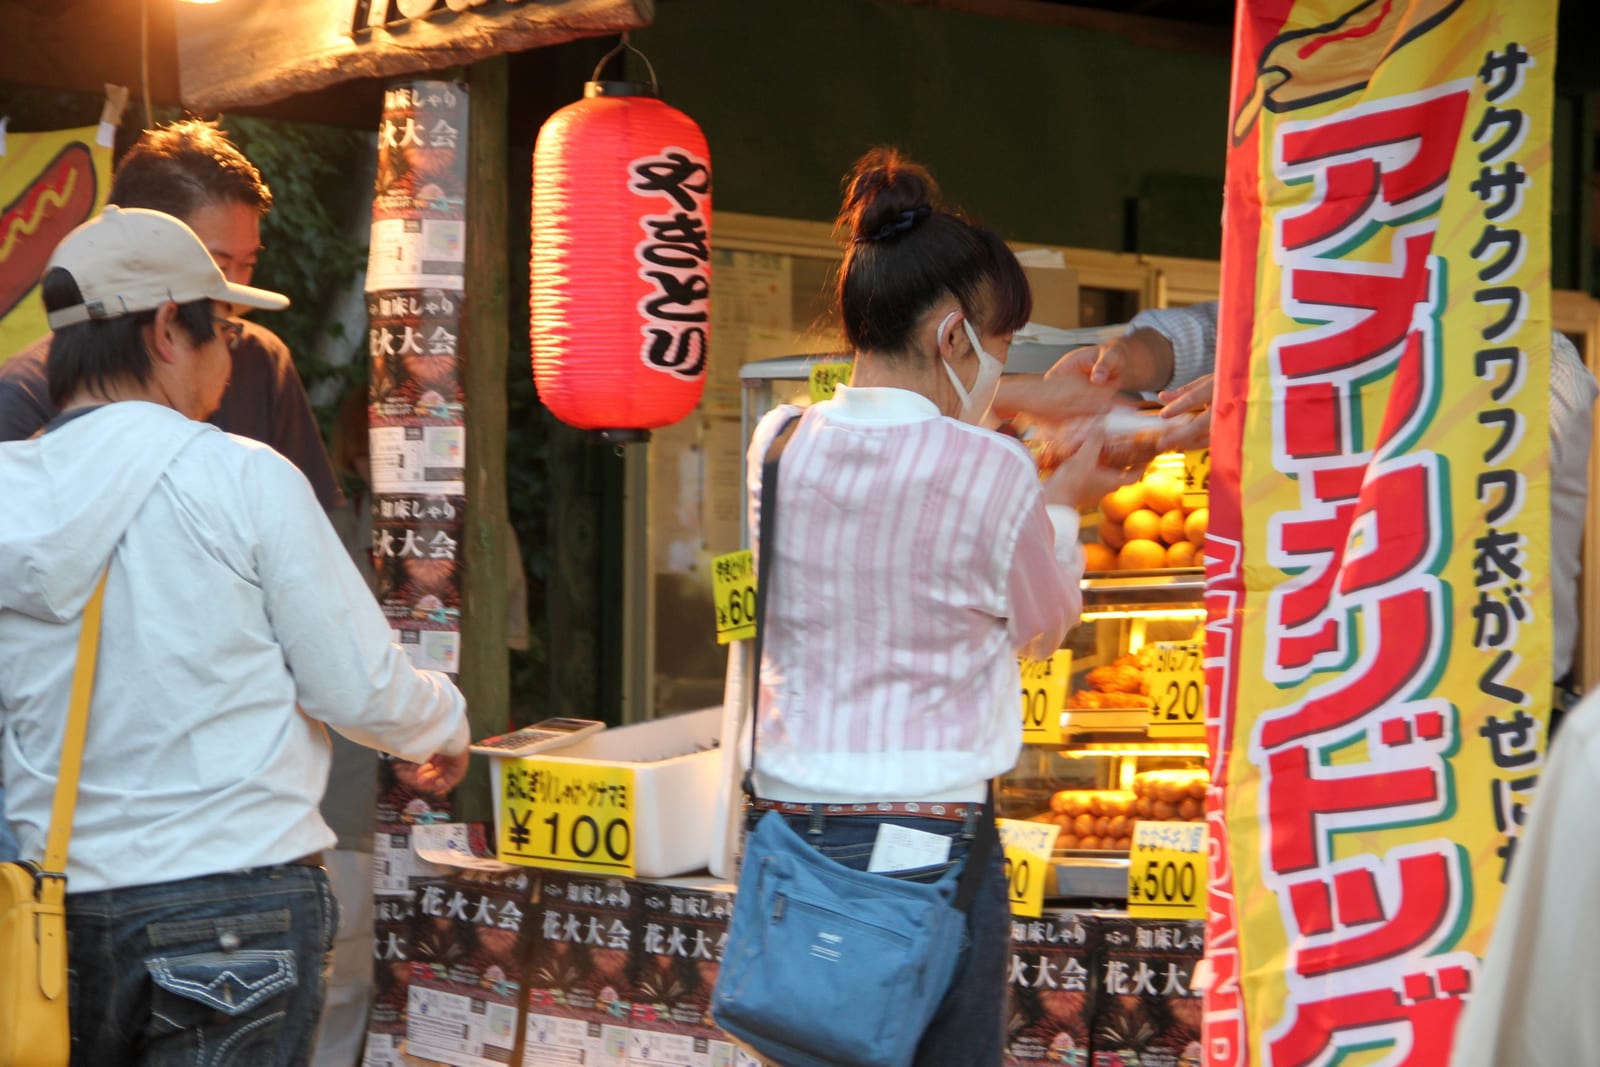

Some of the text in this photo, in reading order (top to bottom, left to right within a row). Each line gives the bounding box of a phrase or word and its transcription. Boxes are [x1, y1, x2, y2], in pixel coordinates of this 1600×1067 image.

[630, 149, 711, 378] やきとり
[508, 807, 631, 862] ¥100
[1130, 860, 1196, 902] ¥500
[420, 885, 525, 932] 花火大会
[542, 909, 632, 951] 花火大会
[1103, 959, 1204, 997] 花火大
